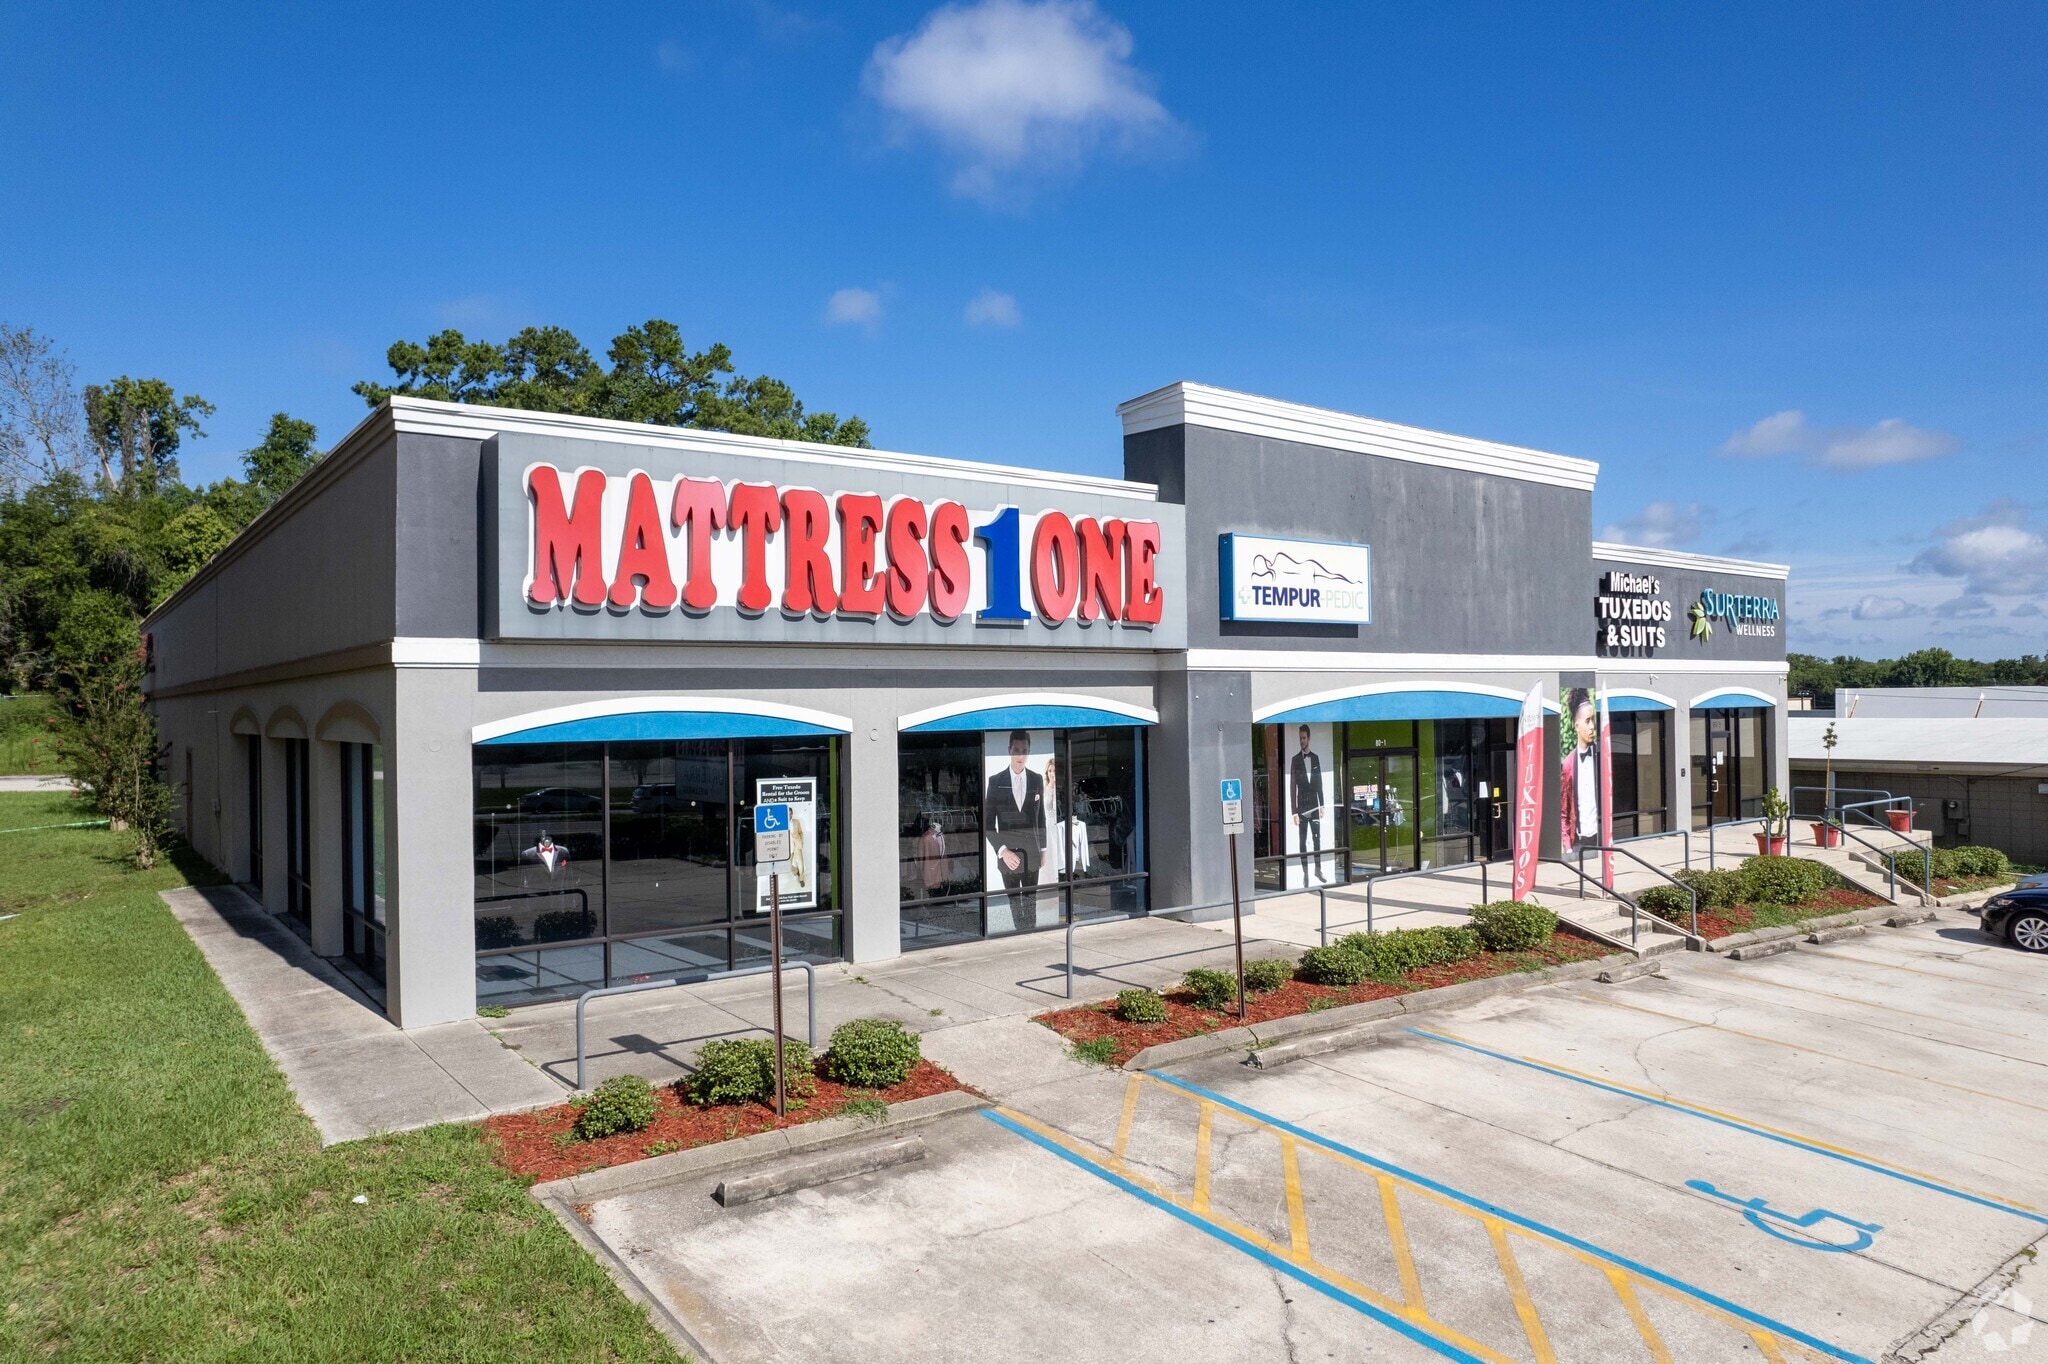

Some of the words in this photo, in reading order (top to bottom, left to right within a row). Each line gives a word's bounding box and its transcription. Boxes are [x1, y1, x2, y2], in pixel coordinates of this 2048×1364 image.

[525, 465, 971, 619] MATTRESS
[974, 507, 1031, 621] 1
[1030, 511, 1164, 625] ONE
[1610, 571, 1660, 595] Michael's
[1599, 597, 1672, 622] TUXEDOS
[1703, 588, 1780, 628] SURTERRA
[1607, 625, 1619, 647] &
[1620, 625, 1666, 648] SUITS
[1736, 624, 1776, 638] WELLNESS
[1515, 742, 1537, 890] TUXEDOS
